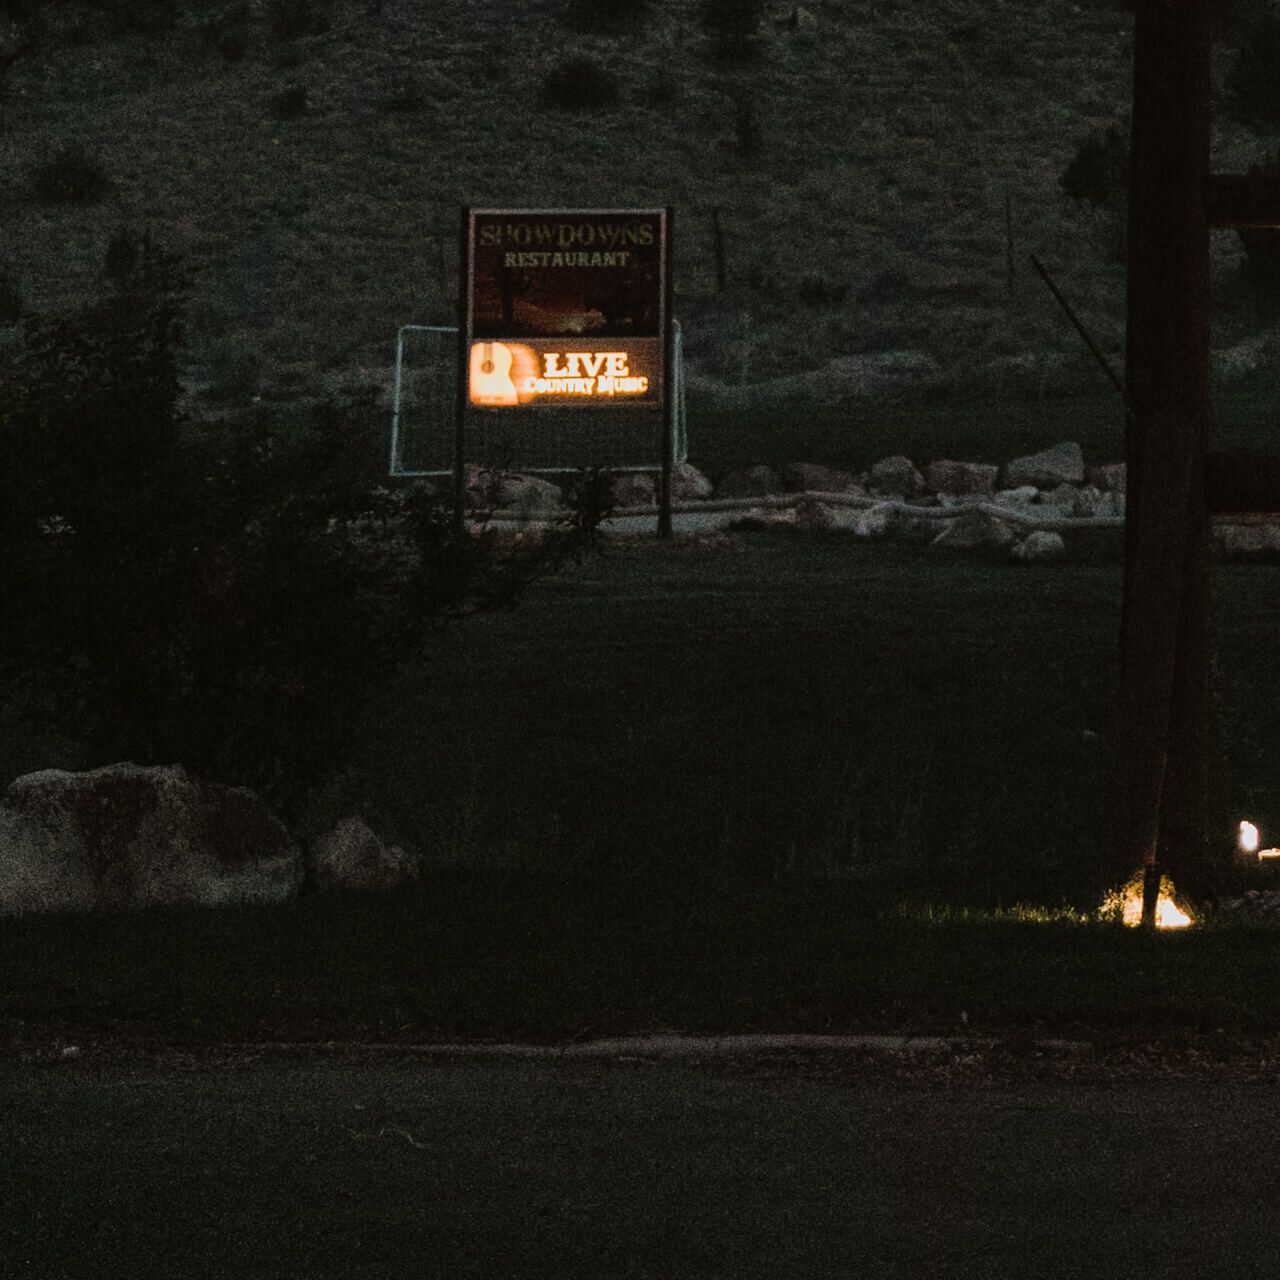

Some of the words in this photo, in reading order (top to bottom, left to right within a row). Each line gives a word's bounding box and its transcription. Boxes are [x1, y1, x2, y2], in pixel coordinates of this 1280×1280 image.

[479, 223, 654, 248] SHOWDOWNS
[505, 251, 630, 267] RESTAURANT
[543, 352, 629, 377] LIVE
